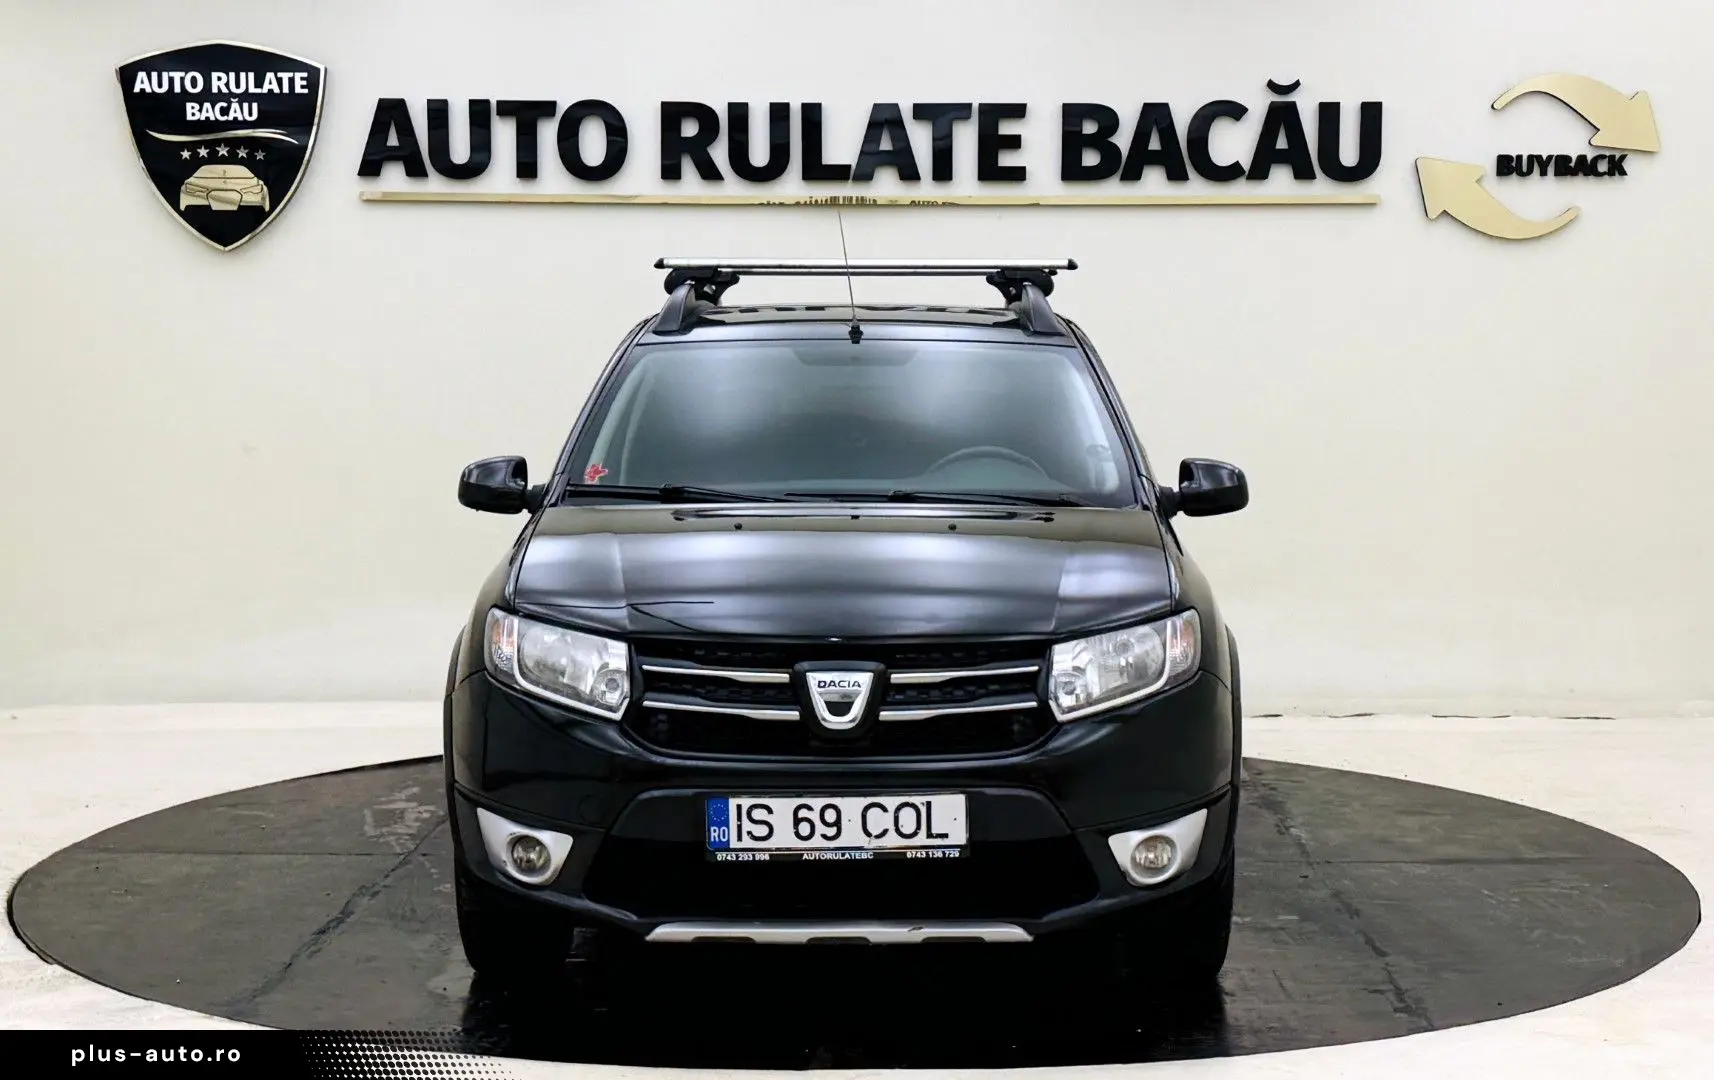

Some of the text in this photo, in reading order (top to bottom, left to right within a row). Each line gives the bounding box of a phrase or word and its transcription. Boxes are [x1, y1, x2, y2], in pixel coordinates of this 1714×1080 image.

[134, 72, 308, 93] AUTO RULATE
[185, 98, 258, 121] BACĂU
[358, 79, 1383, 182] AUTO RULATE BACĂU
[1496, 153, 1628, 178] BUYBACK
[817, 680, 862, 688] DACIA
[736, 801, 949, 843] IS 69 COL
[710, 826, 728, 842] RO
[802, 851, 874, 860] AUTORULATEBC
